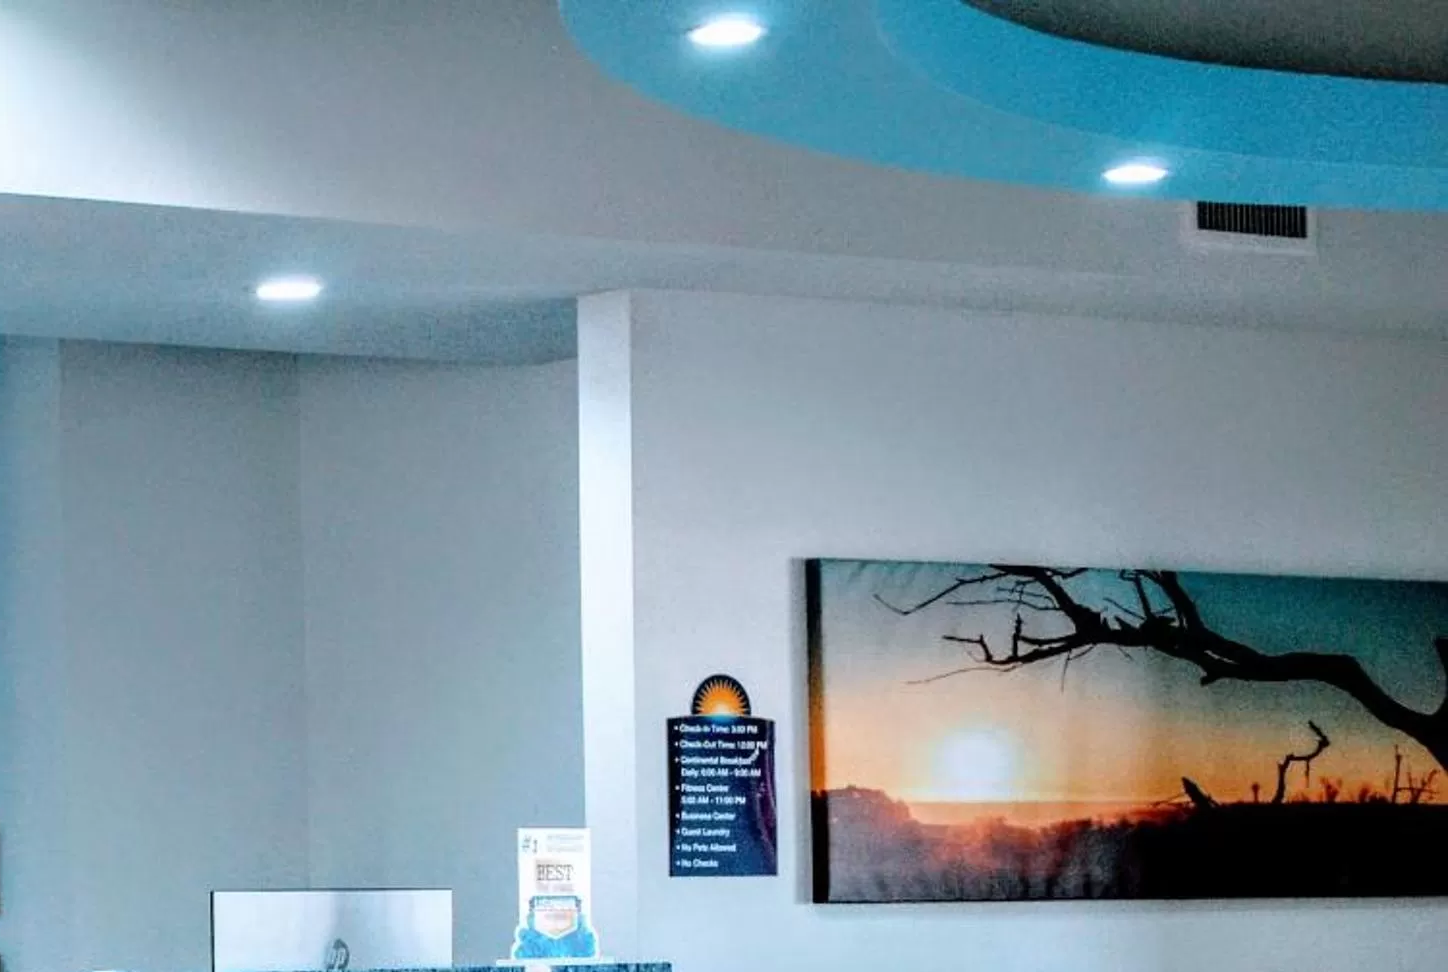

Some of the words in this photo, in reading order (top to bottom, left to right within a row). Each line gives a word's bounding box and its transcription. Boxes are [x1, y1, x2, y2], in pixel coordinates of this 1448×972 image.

[681, 783, 705, 793] Fitness
[706, 783, 730, 793] Center
[681, 811, 712, 821] Business
[712, 811, 736, 821] Center
[681, 827, 701, 837] Guest
[702, 828, 730, 838] Laundry
[710, 843, 737, 852] Allowed
[536, 864, 573, 881] BEST
